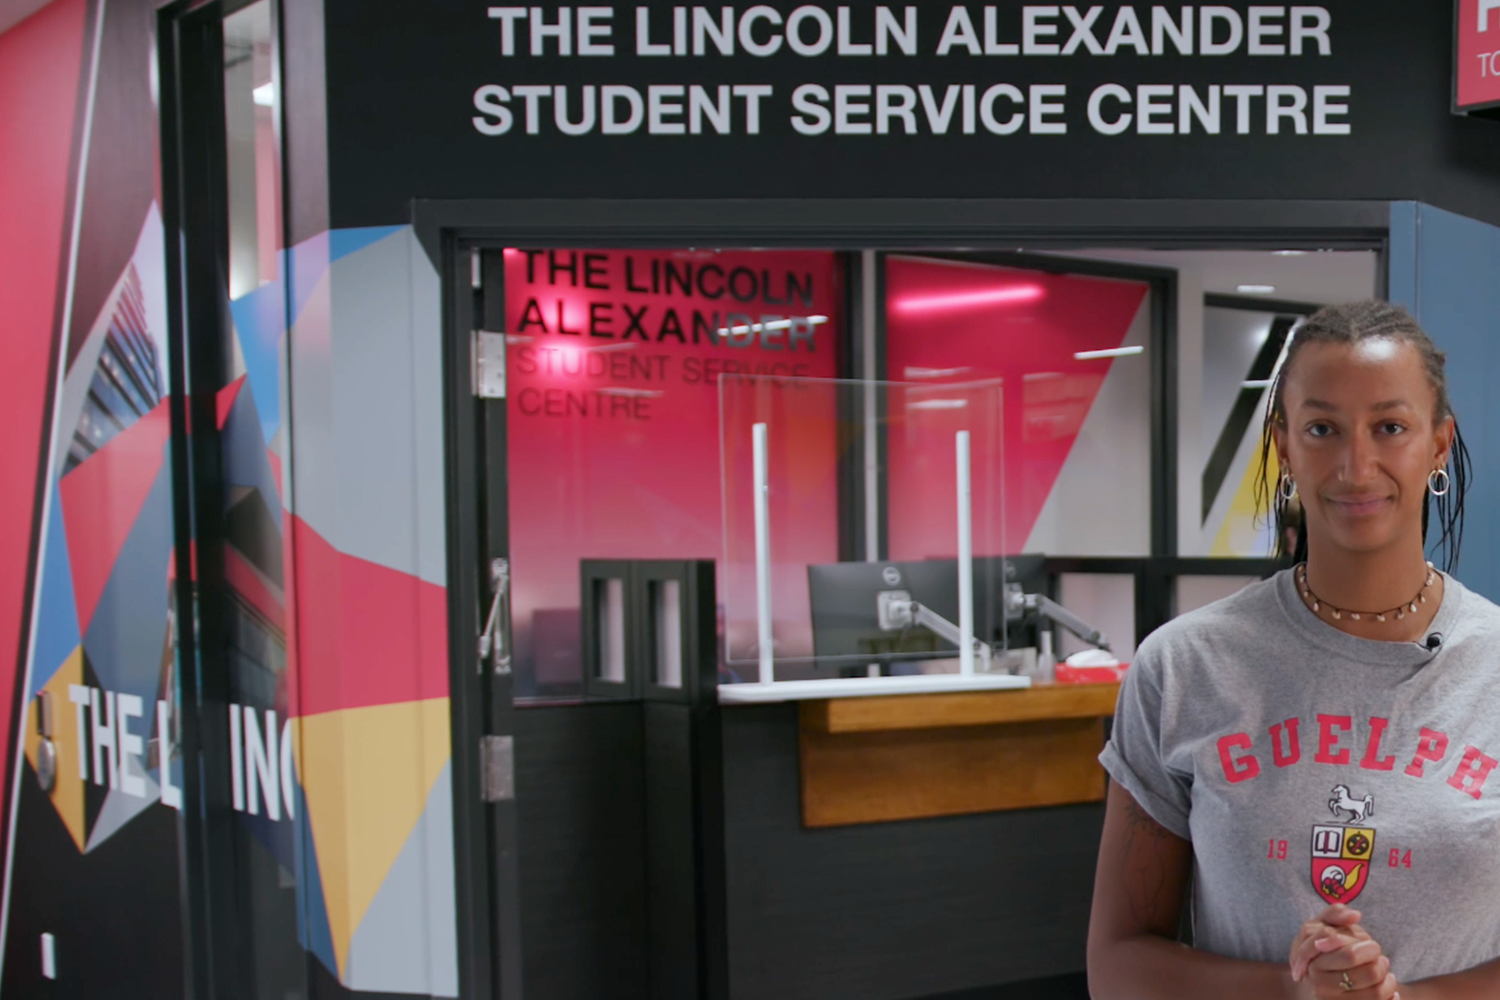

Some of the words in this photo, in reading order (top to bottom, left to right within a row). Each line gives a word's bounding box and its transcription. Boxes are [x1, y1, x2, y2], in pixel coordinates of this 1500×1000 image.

[488, 6, 615, 56] THE
[636, 5, 918, 57] LINCOLN
[936, 5, 1332, 56] ALEXANDER
[472, 84, 773, 136] STUDENT
[790, 83, 1067, 136] SERVICE
[1087, 83, 1351, 136] CENTRE
[520, 249, 610, 290] THE
[625, 256, 813, 307] LINCOLN
[517, 297, 816, 351] ALEXANDER
[516, 347, 671, 382] STUDENT
[682, 356, 811, 390] SERVICE
[517, 387, 652, 419] CENTRE
[68, 684, 147, 798] THE
[1217, 713, 1499, 800] GUELPH
[1268, 839, 1288, 860] 19
[1388, 848, 1412, 869] 64
